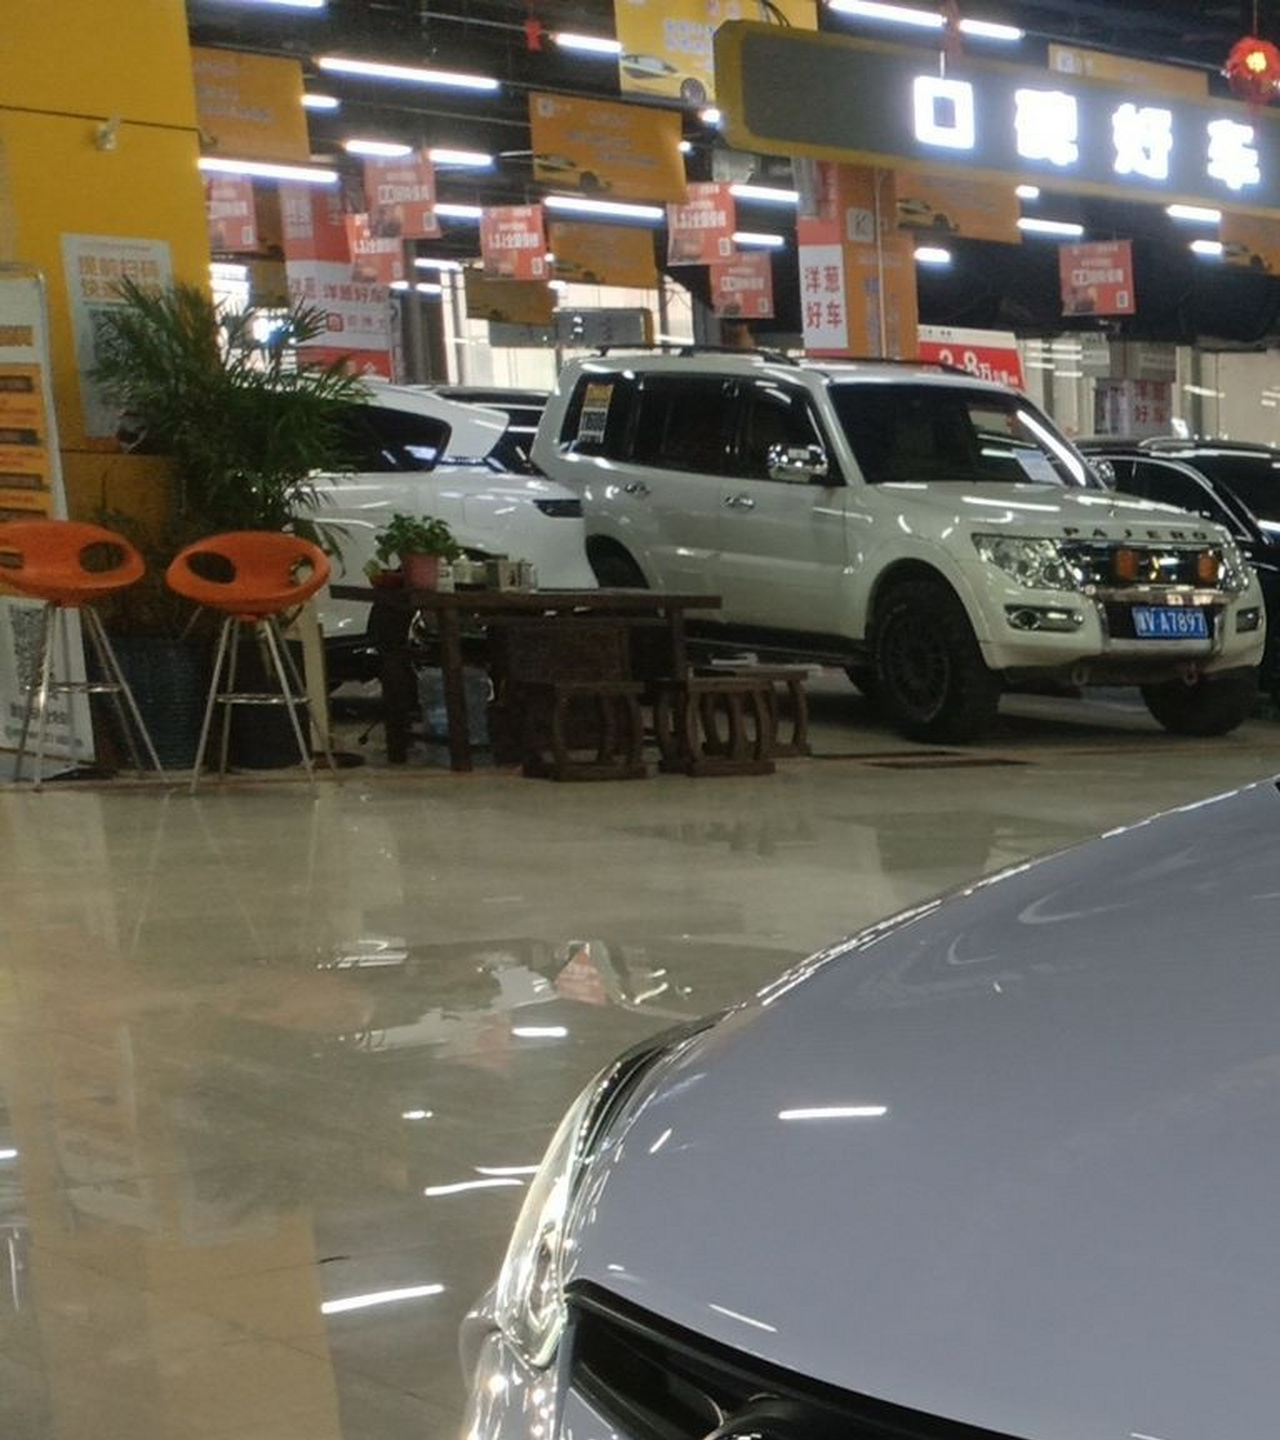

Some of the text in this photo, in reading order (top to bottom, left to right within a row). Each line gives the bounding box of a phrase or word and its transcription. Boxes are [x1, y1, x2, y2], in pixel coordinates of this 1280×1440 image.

[804, 265, 840, 293] 洋葱
[805, 300, 843, 329] 好车
[1063, 526, 1208, 541] PAJERO
